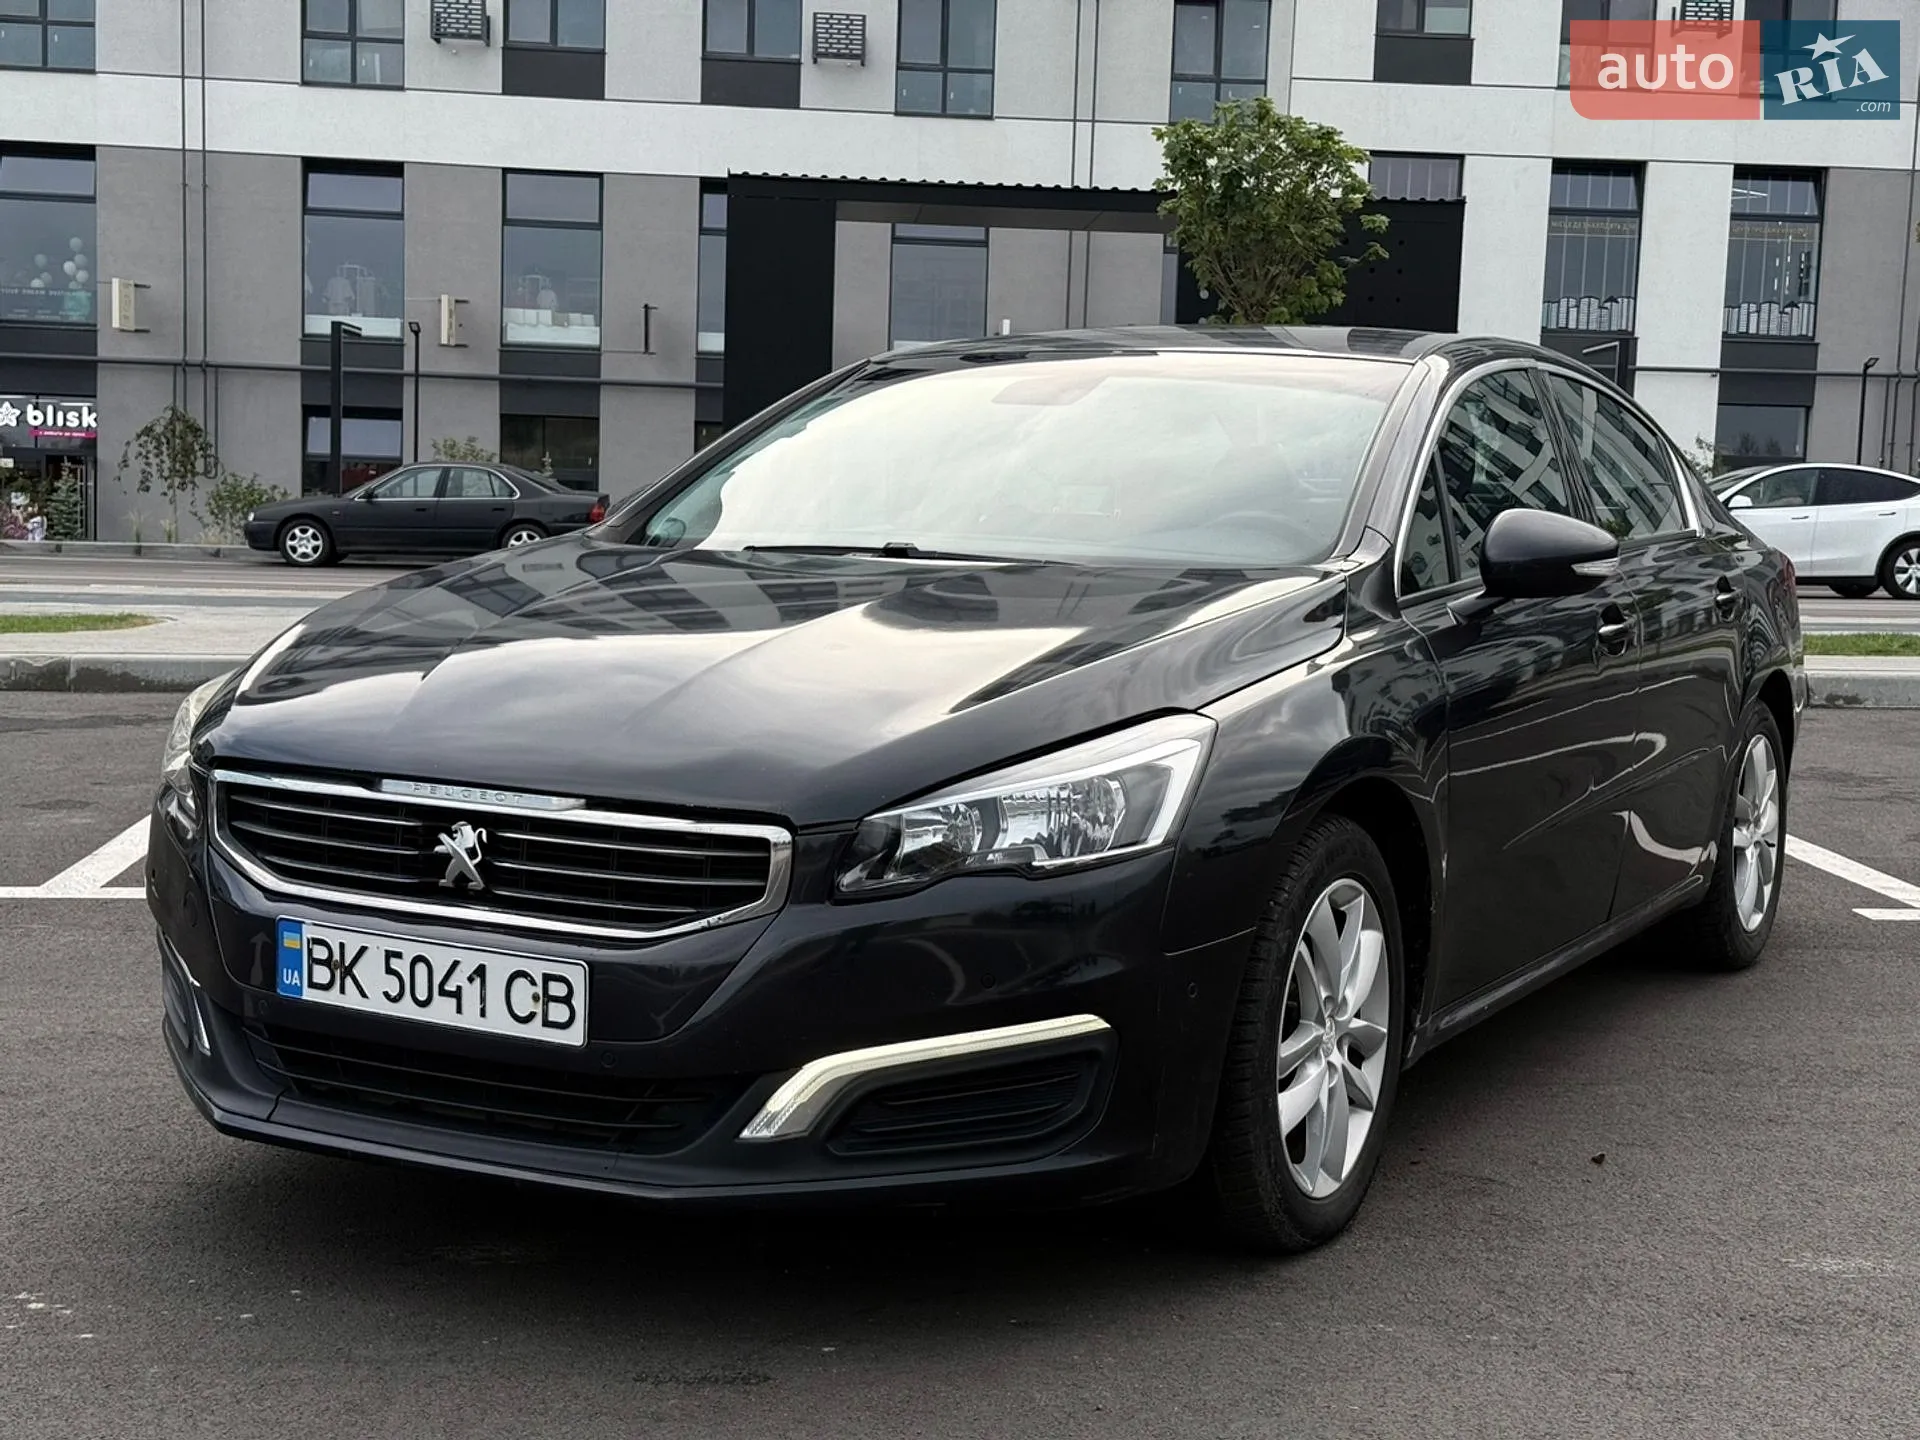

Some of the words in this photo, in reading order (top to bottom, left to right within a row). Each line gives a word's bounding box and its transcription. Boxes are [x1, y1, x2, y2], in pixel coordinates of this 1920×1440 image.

[26, 403, 98, 428] blisk
[411, 782, 524, 804] PEUGEOT
[282, 970, 301, 987] UA
[307, 936, 369, 999] BK
[382, 949, 488, 1018] 5041
[504, 968, 576, 1030] CB
